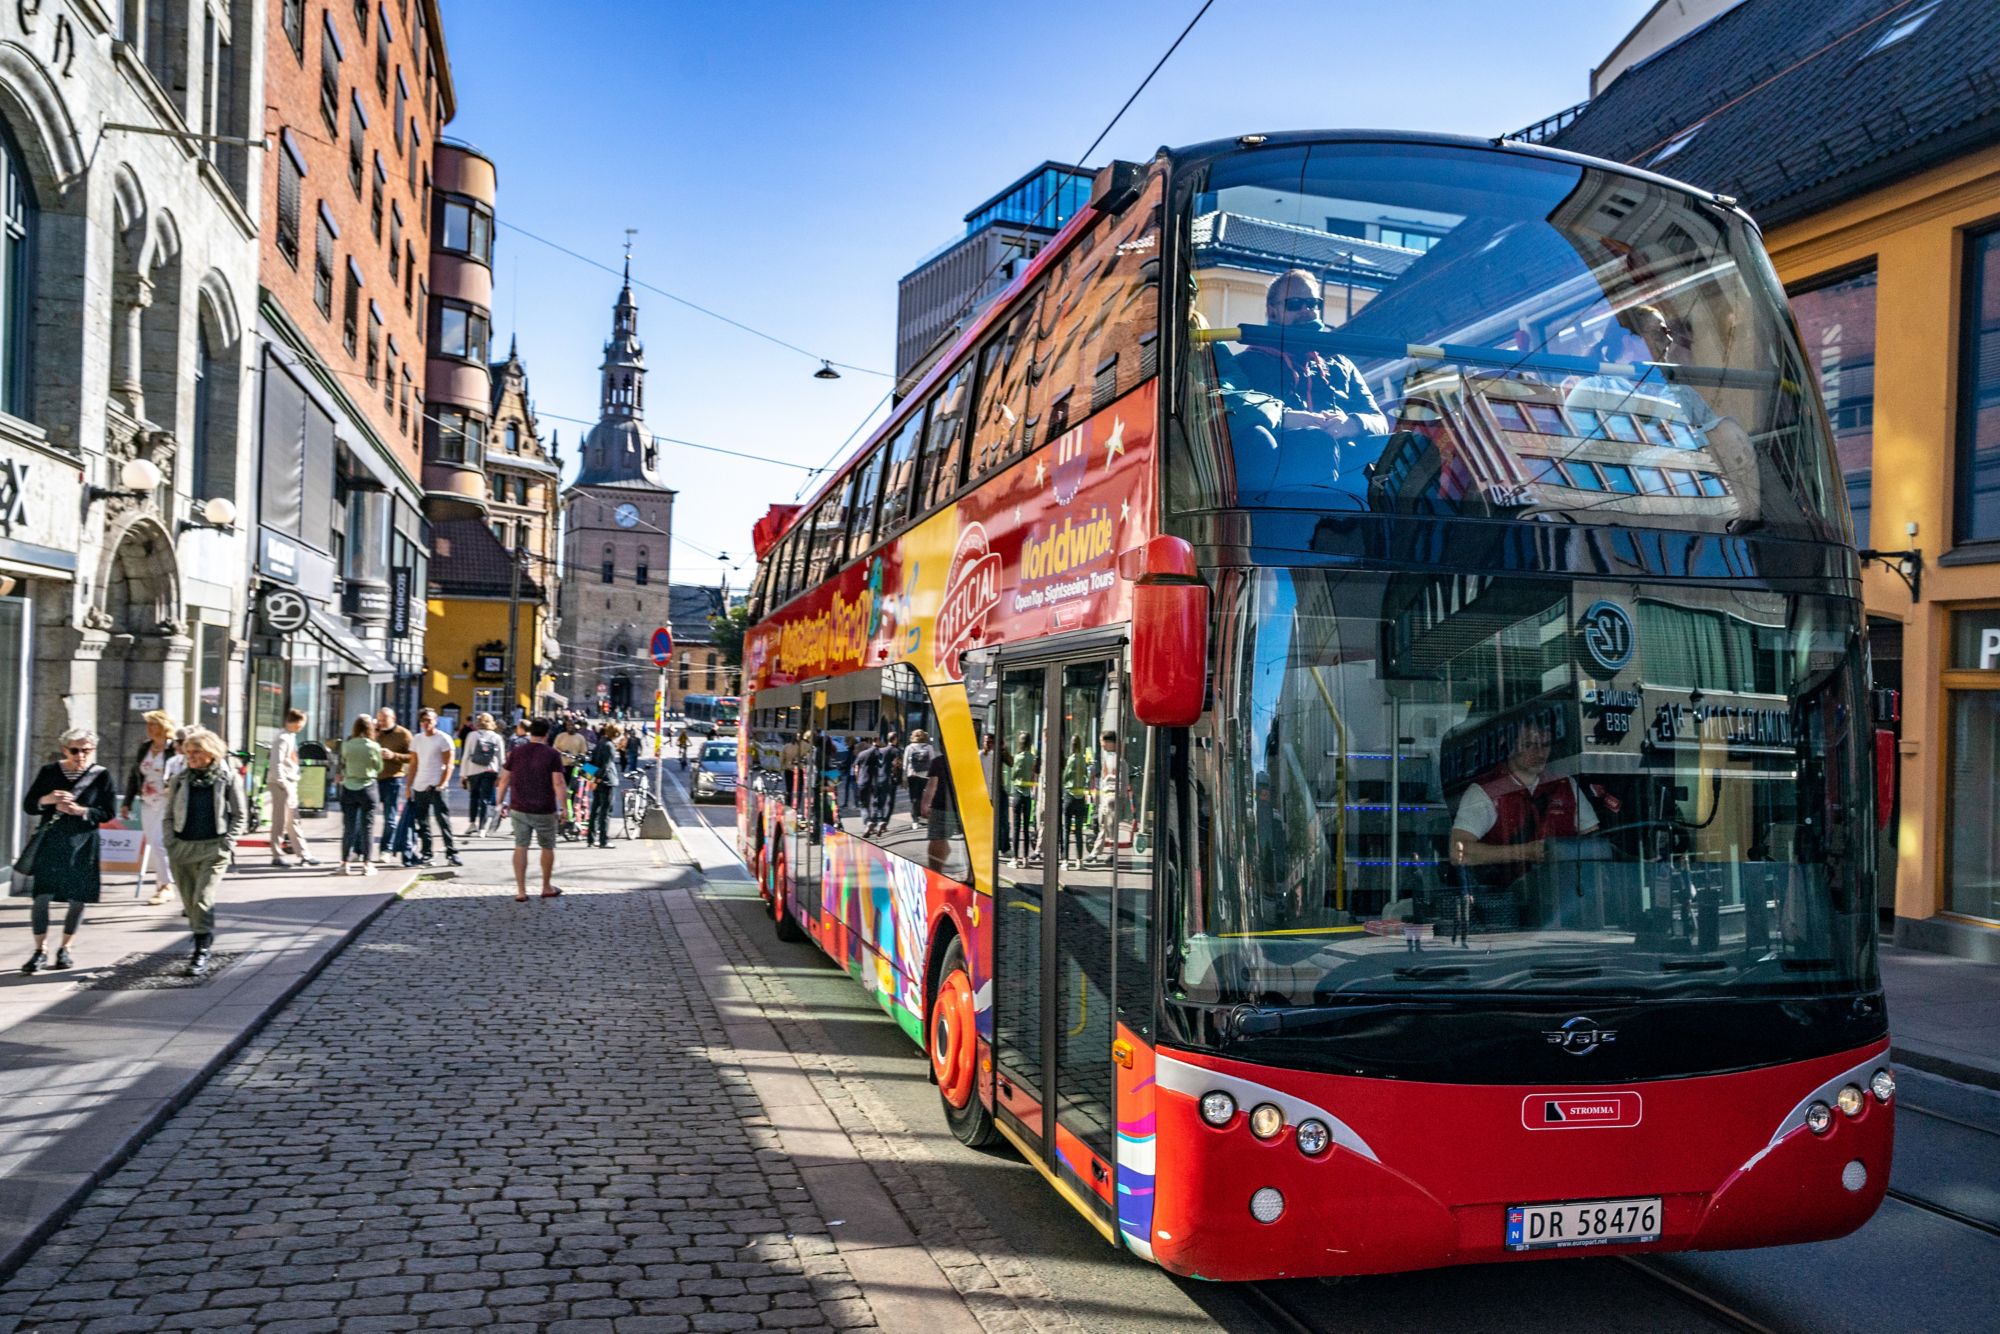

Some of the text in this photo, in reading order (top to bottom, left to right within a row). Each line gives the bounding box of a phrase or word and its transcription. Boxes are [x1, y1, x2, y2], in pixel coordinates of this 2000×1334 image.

[1021, 508, 1112, 580] Worldwide
[394, 572, 407, 632] SECOND HAND
[1045, 577, 1089, 604] Sightseeing
[1090, 571, 1115, 590] Tours
[940, 562, 997, 653] OFFICIAL
[1570, 1106, 1614, 1115] STROMMA
[1511, 1230, 1520, 1239] N
[1529, 1205, 1655, 1239] DR 58476
[1556, 1238, 1608, 1247] www.europart.net
